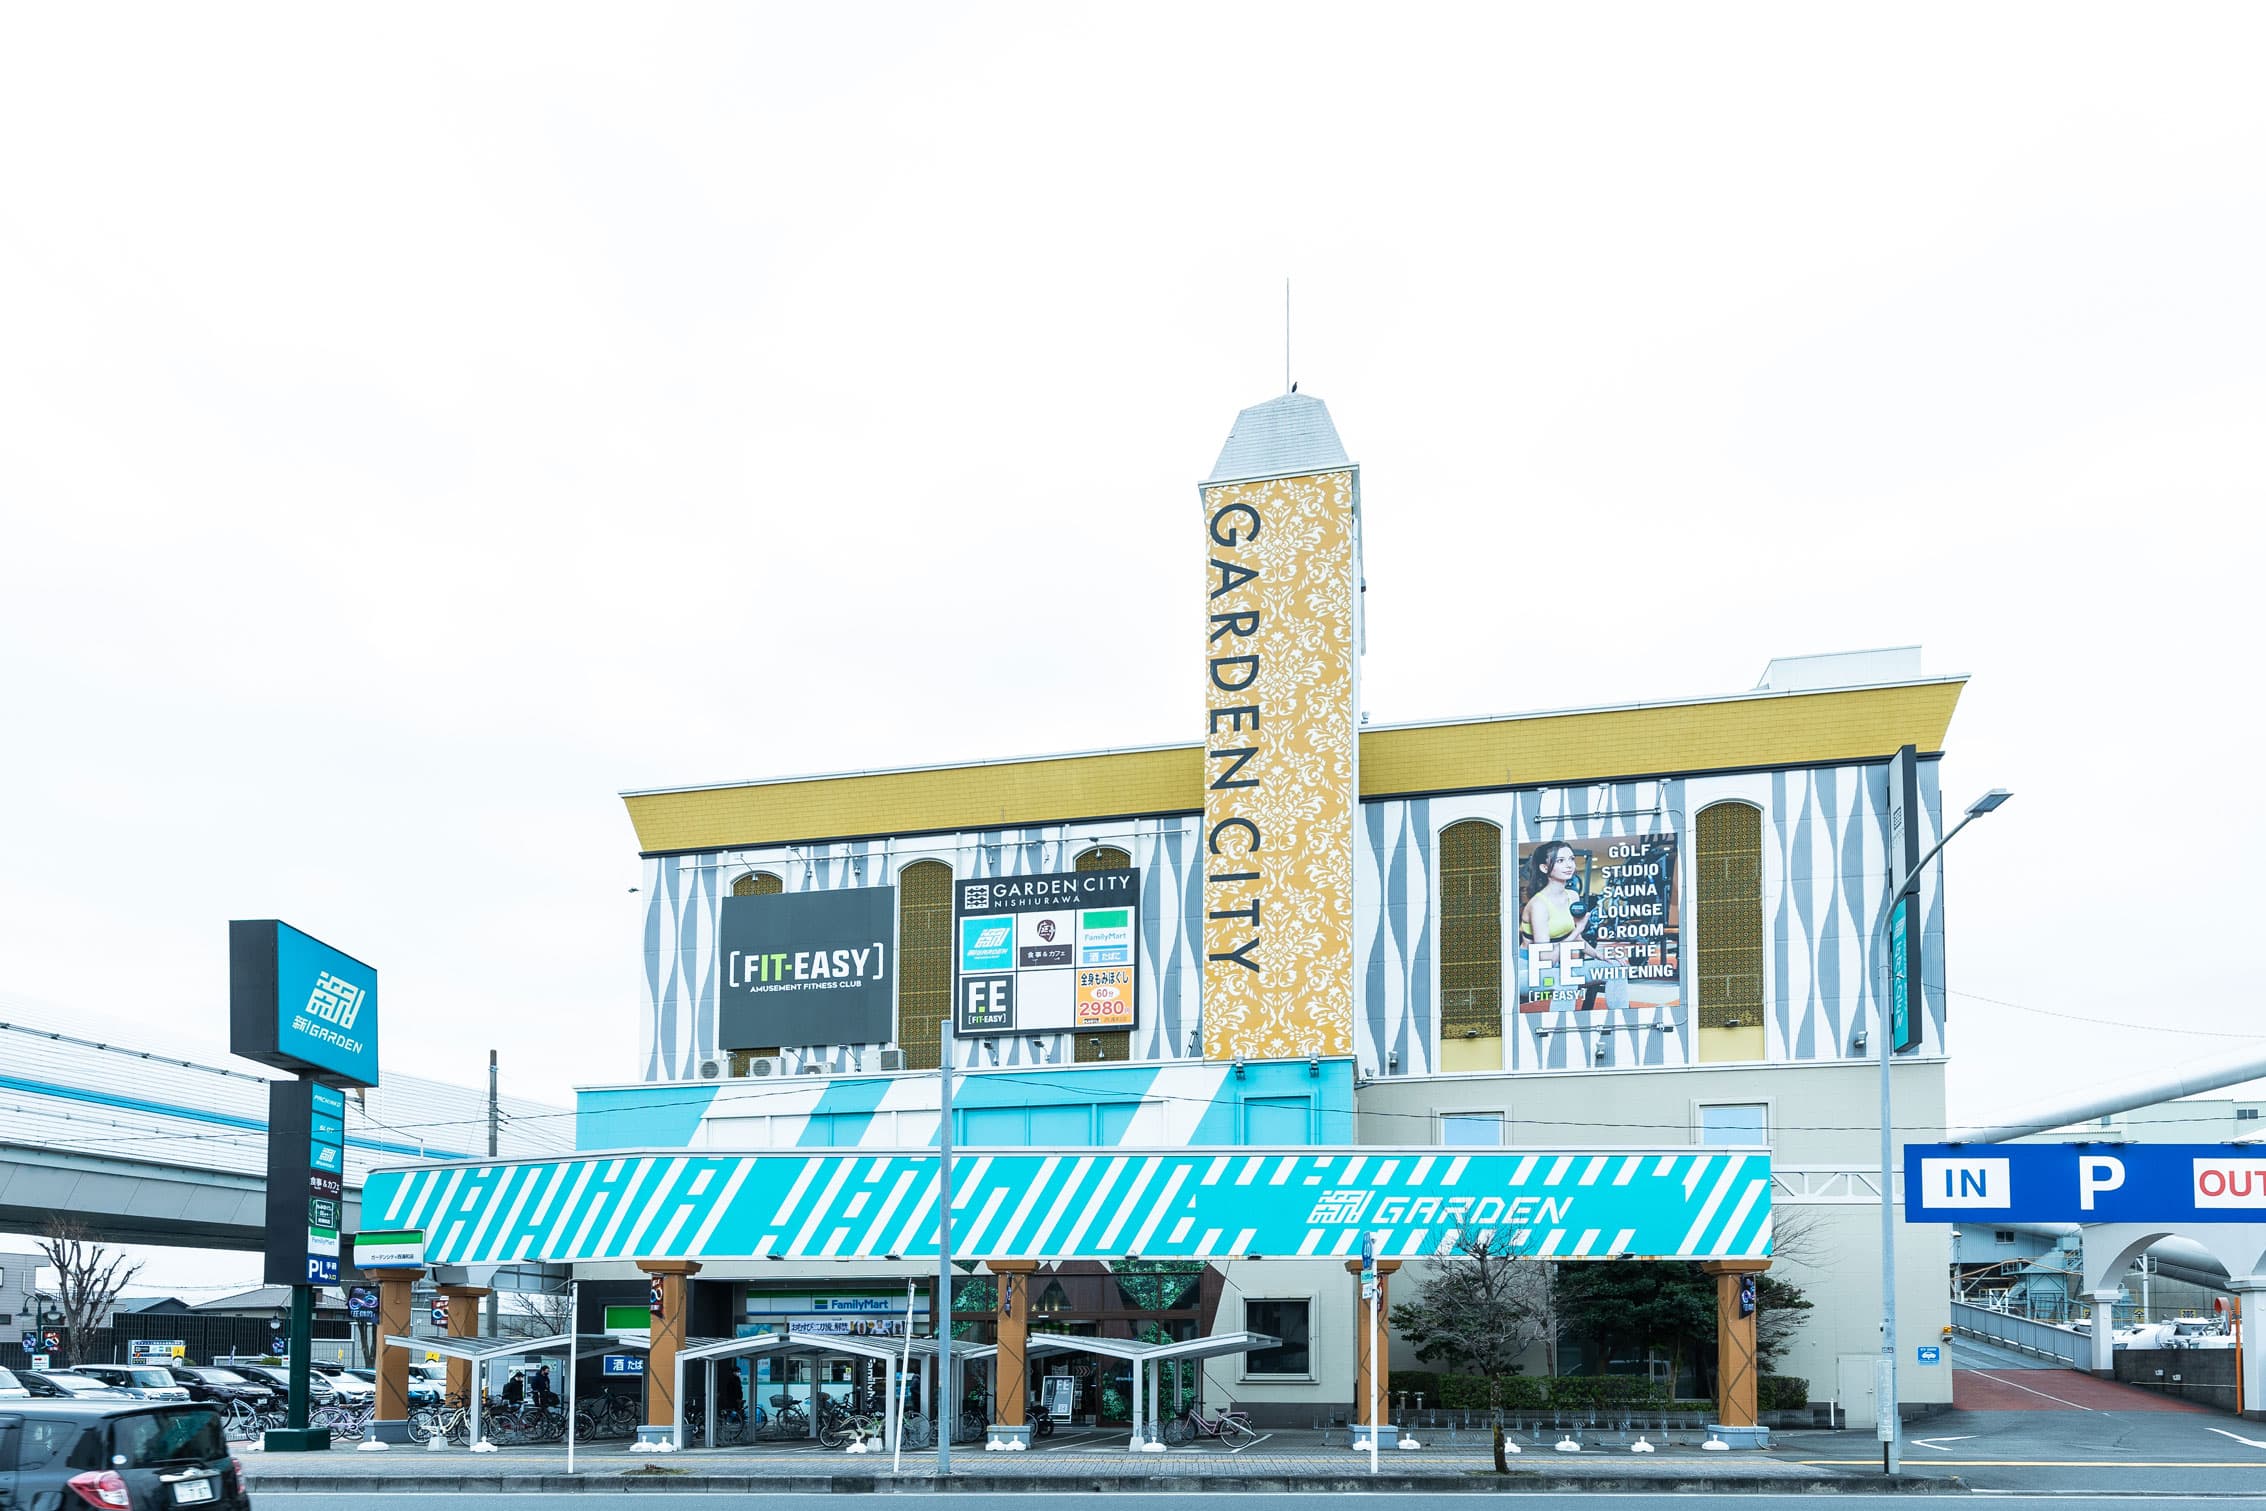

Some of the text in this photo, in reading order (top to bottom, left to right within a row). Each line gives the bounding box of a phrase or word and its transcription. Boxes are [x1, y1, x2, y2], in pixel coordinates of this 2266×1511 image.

[1208, 503, 1262, 974] GARDEN CITY
[1609, 844, 1651, 858] GOLF
[1602, 863, 1659, 879] STUDIO
[993, 875, 1130, 898] GARDEN CITY
[1603, 884, 1658, 898] SAUNA
[994, 895, 1080, 908] NISHIURAWA
[1599, 904, 1663, 919] LOUNGE
[1084, 931, 1127, 943] FamilyMart
[1081, 970, 1129, 986] 全身もみほぐし
[1590, 964, 1674, 980] WHITENING
[750, 980, 862, 993] AMUSEMENT FITNESS CLUB
[1945, 1168, 1987, 1198] IN
[2078, 1155, 2127, 1210] P
[1371, 1196, 1575, 1224] GARDEN
[831, 1299, 889, 1311] FamilyMart
[612, 1359, 625, 1371] 酒
